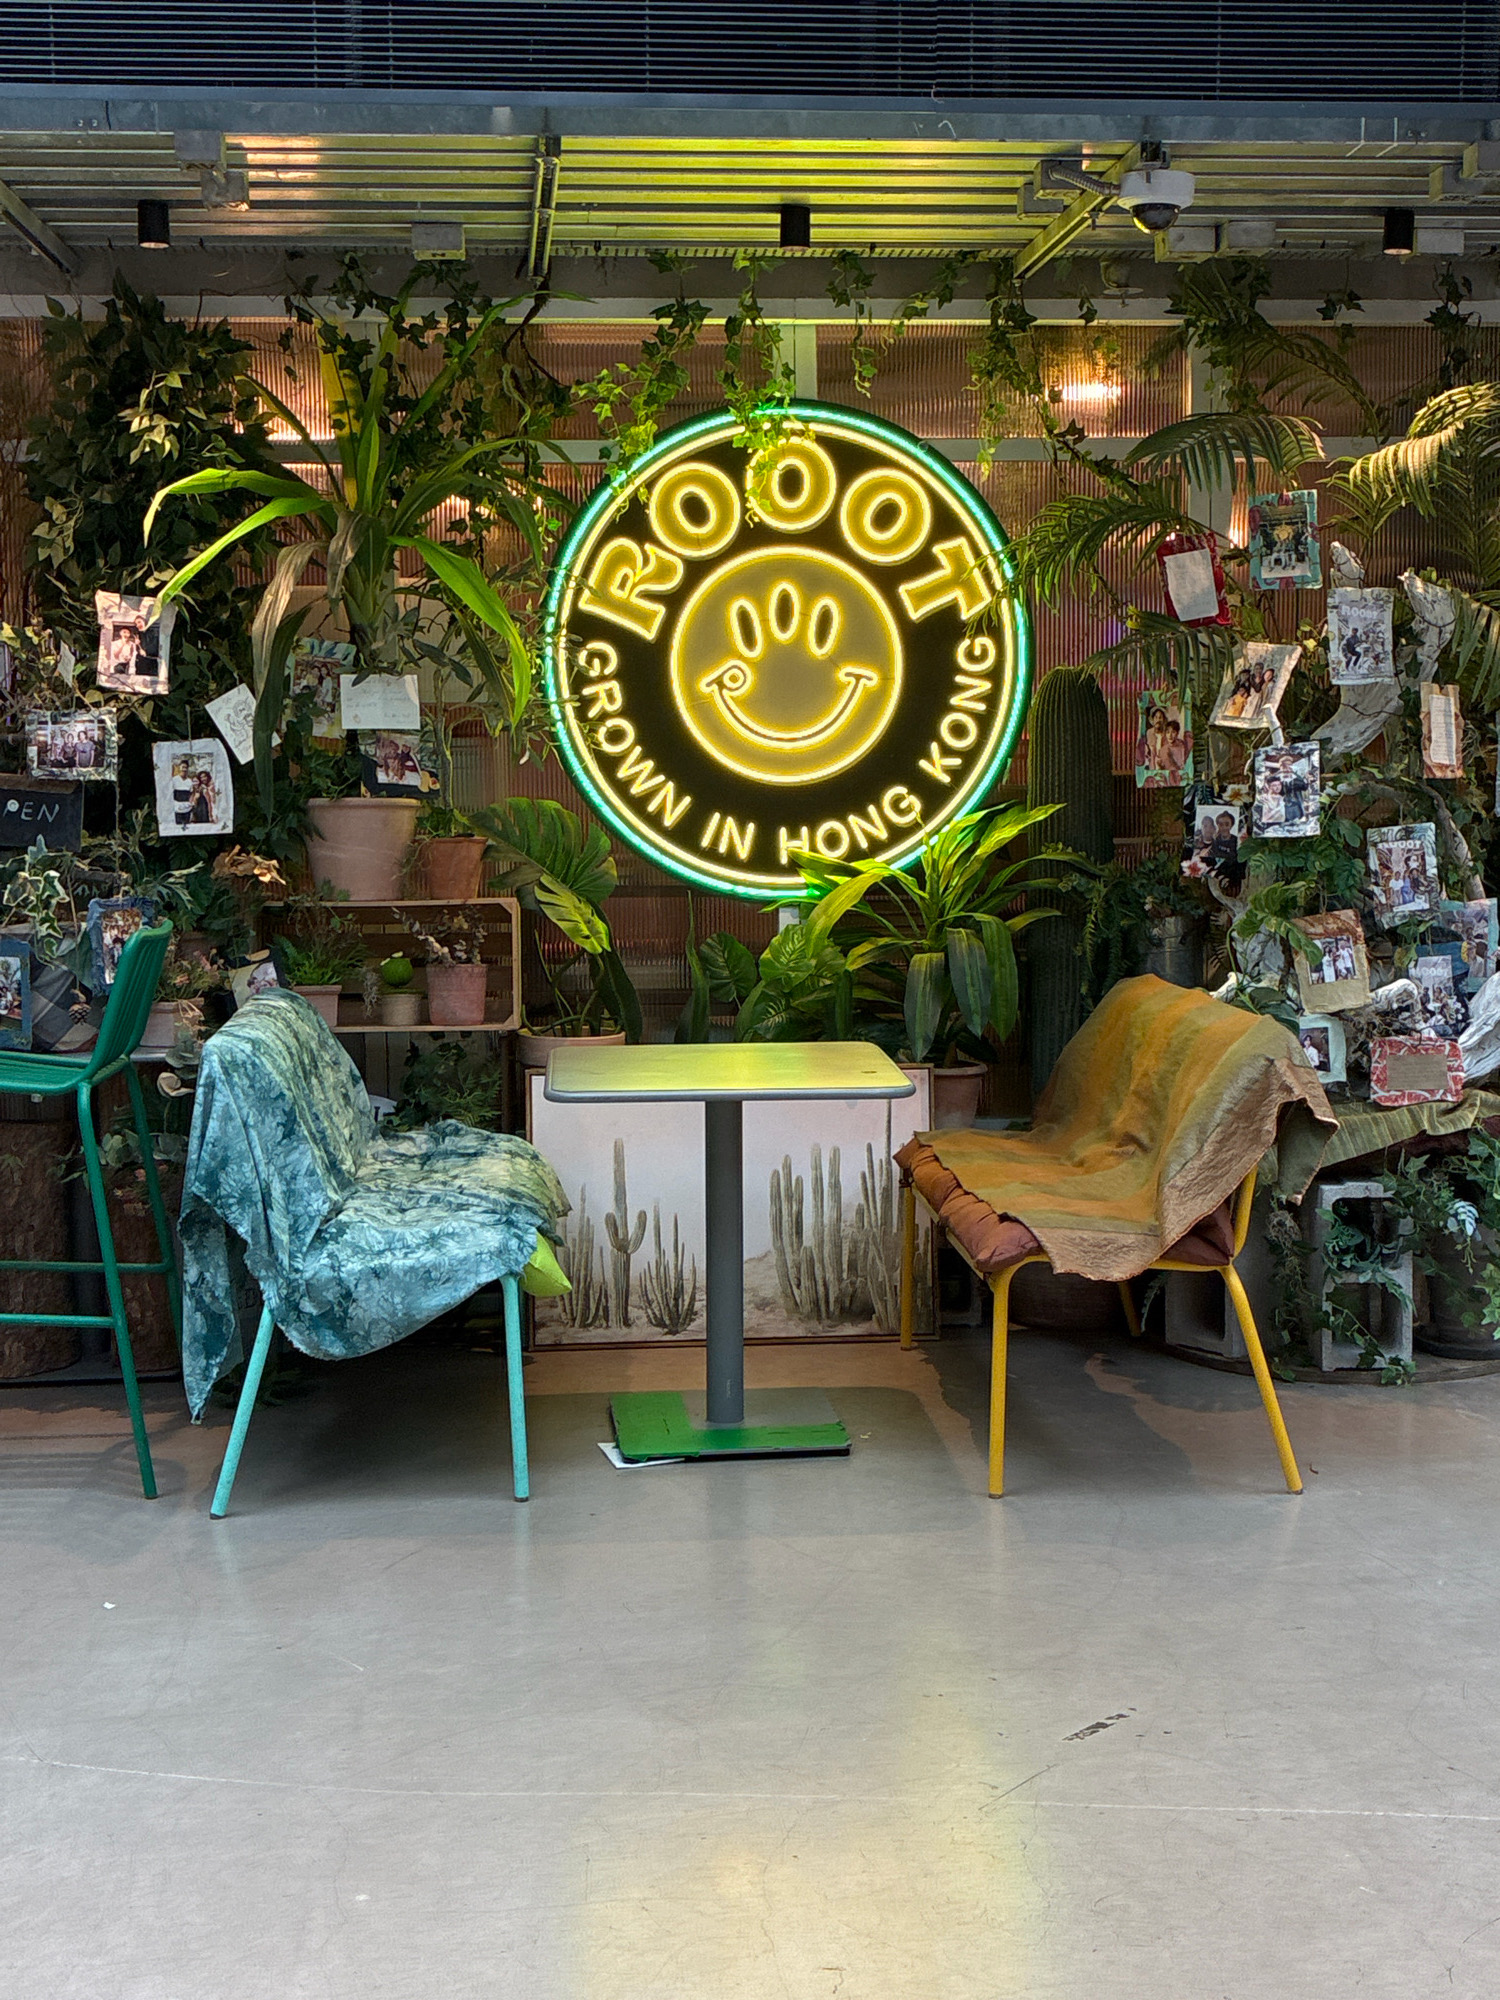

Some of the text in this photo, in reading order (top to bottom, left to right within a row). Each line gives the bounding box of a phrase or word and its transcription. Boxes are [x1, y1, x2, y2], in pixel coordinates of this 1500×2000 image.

[579, 436, 991, 641] ROOOT
[578, 636, 996, 865] GROWN IN HONG KONG
